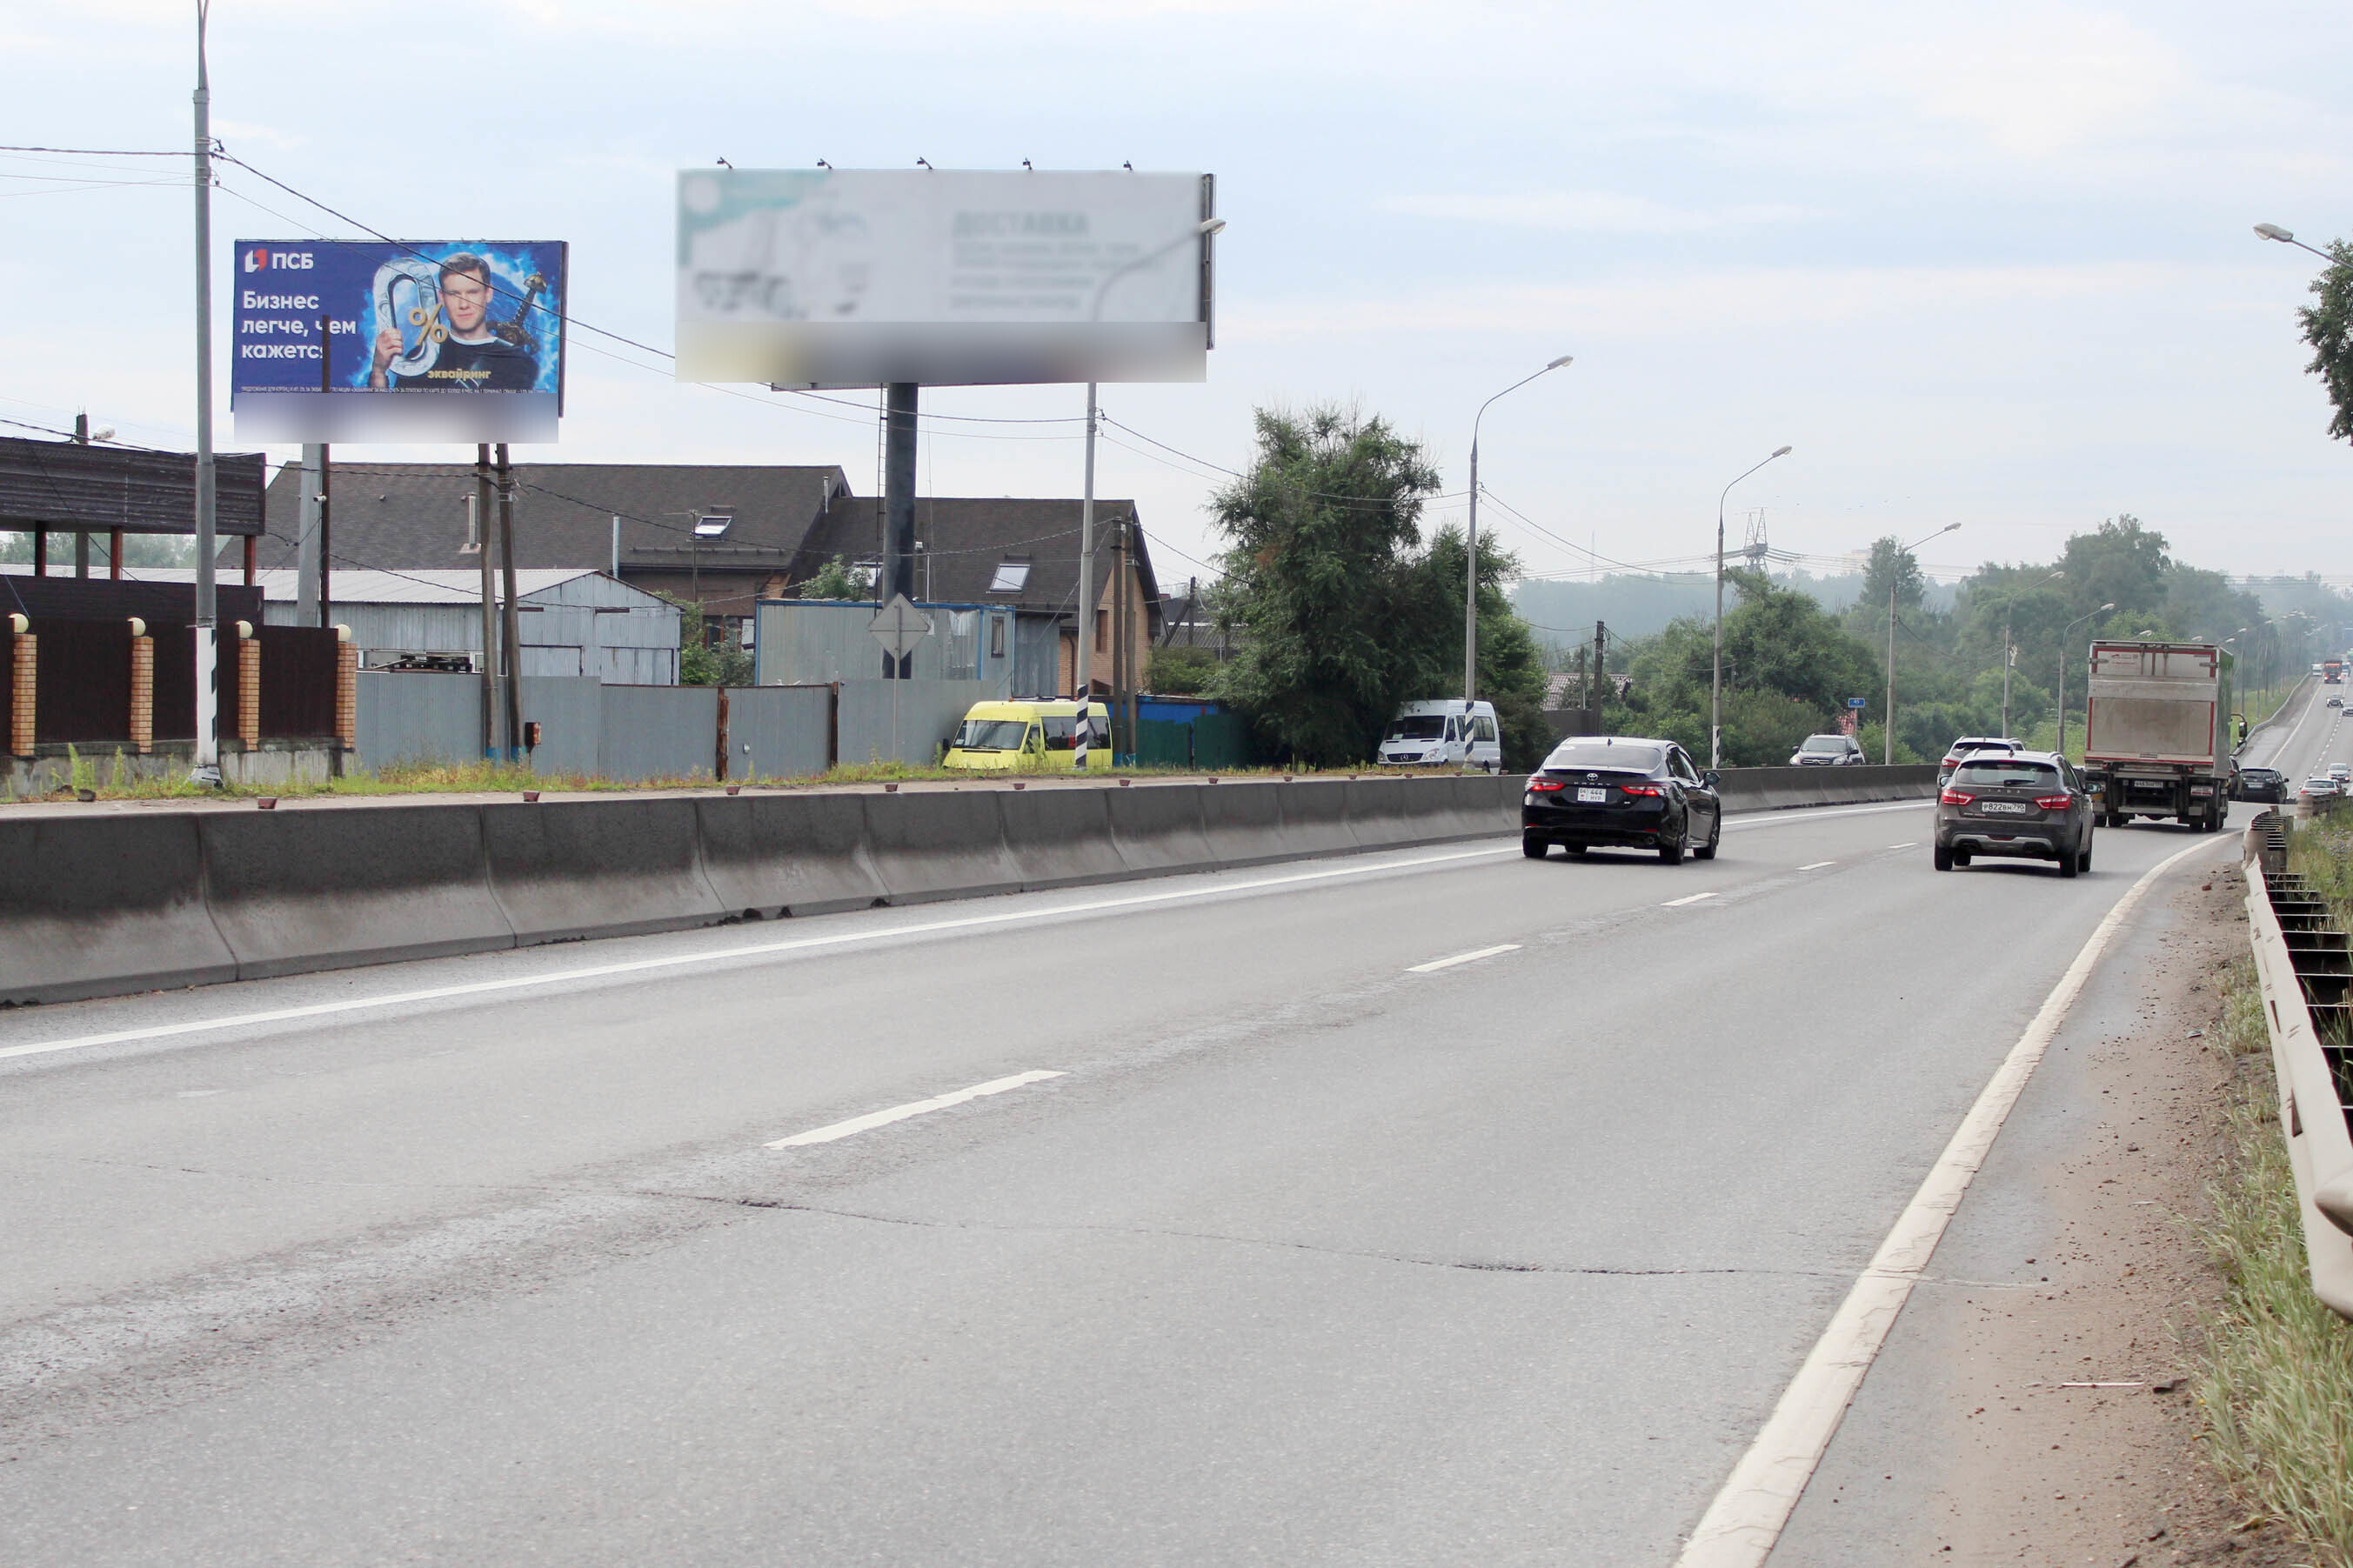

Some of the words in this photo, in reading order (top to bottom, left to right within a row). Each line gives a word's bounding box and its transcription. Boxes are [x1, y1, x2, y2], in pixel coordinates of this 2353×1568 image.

[272, 252, 314, 270] ПСБ
[244, 290, 320, 310] Бизнес
[241, 319, 309, 337] легче,
[242, 344, 324, 359] кажетс
[427, 368, 491, 381] эквайринг
